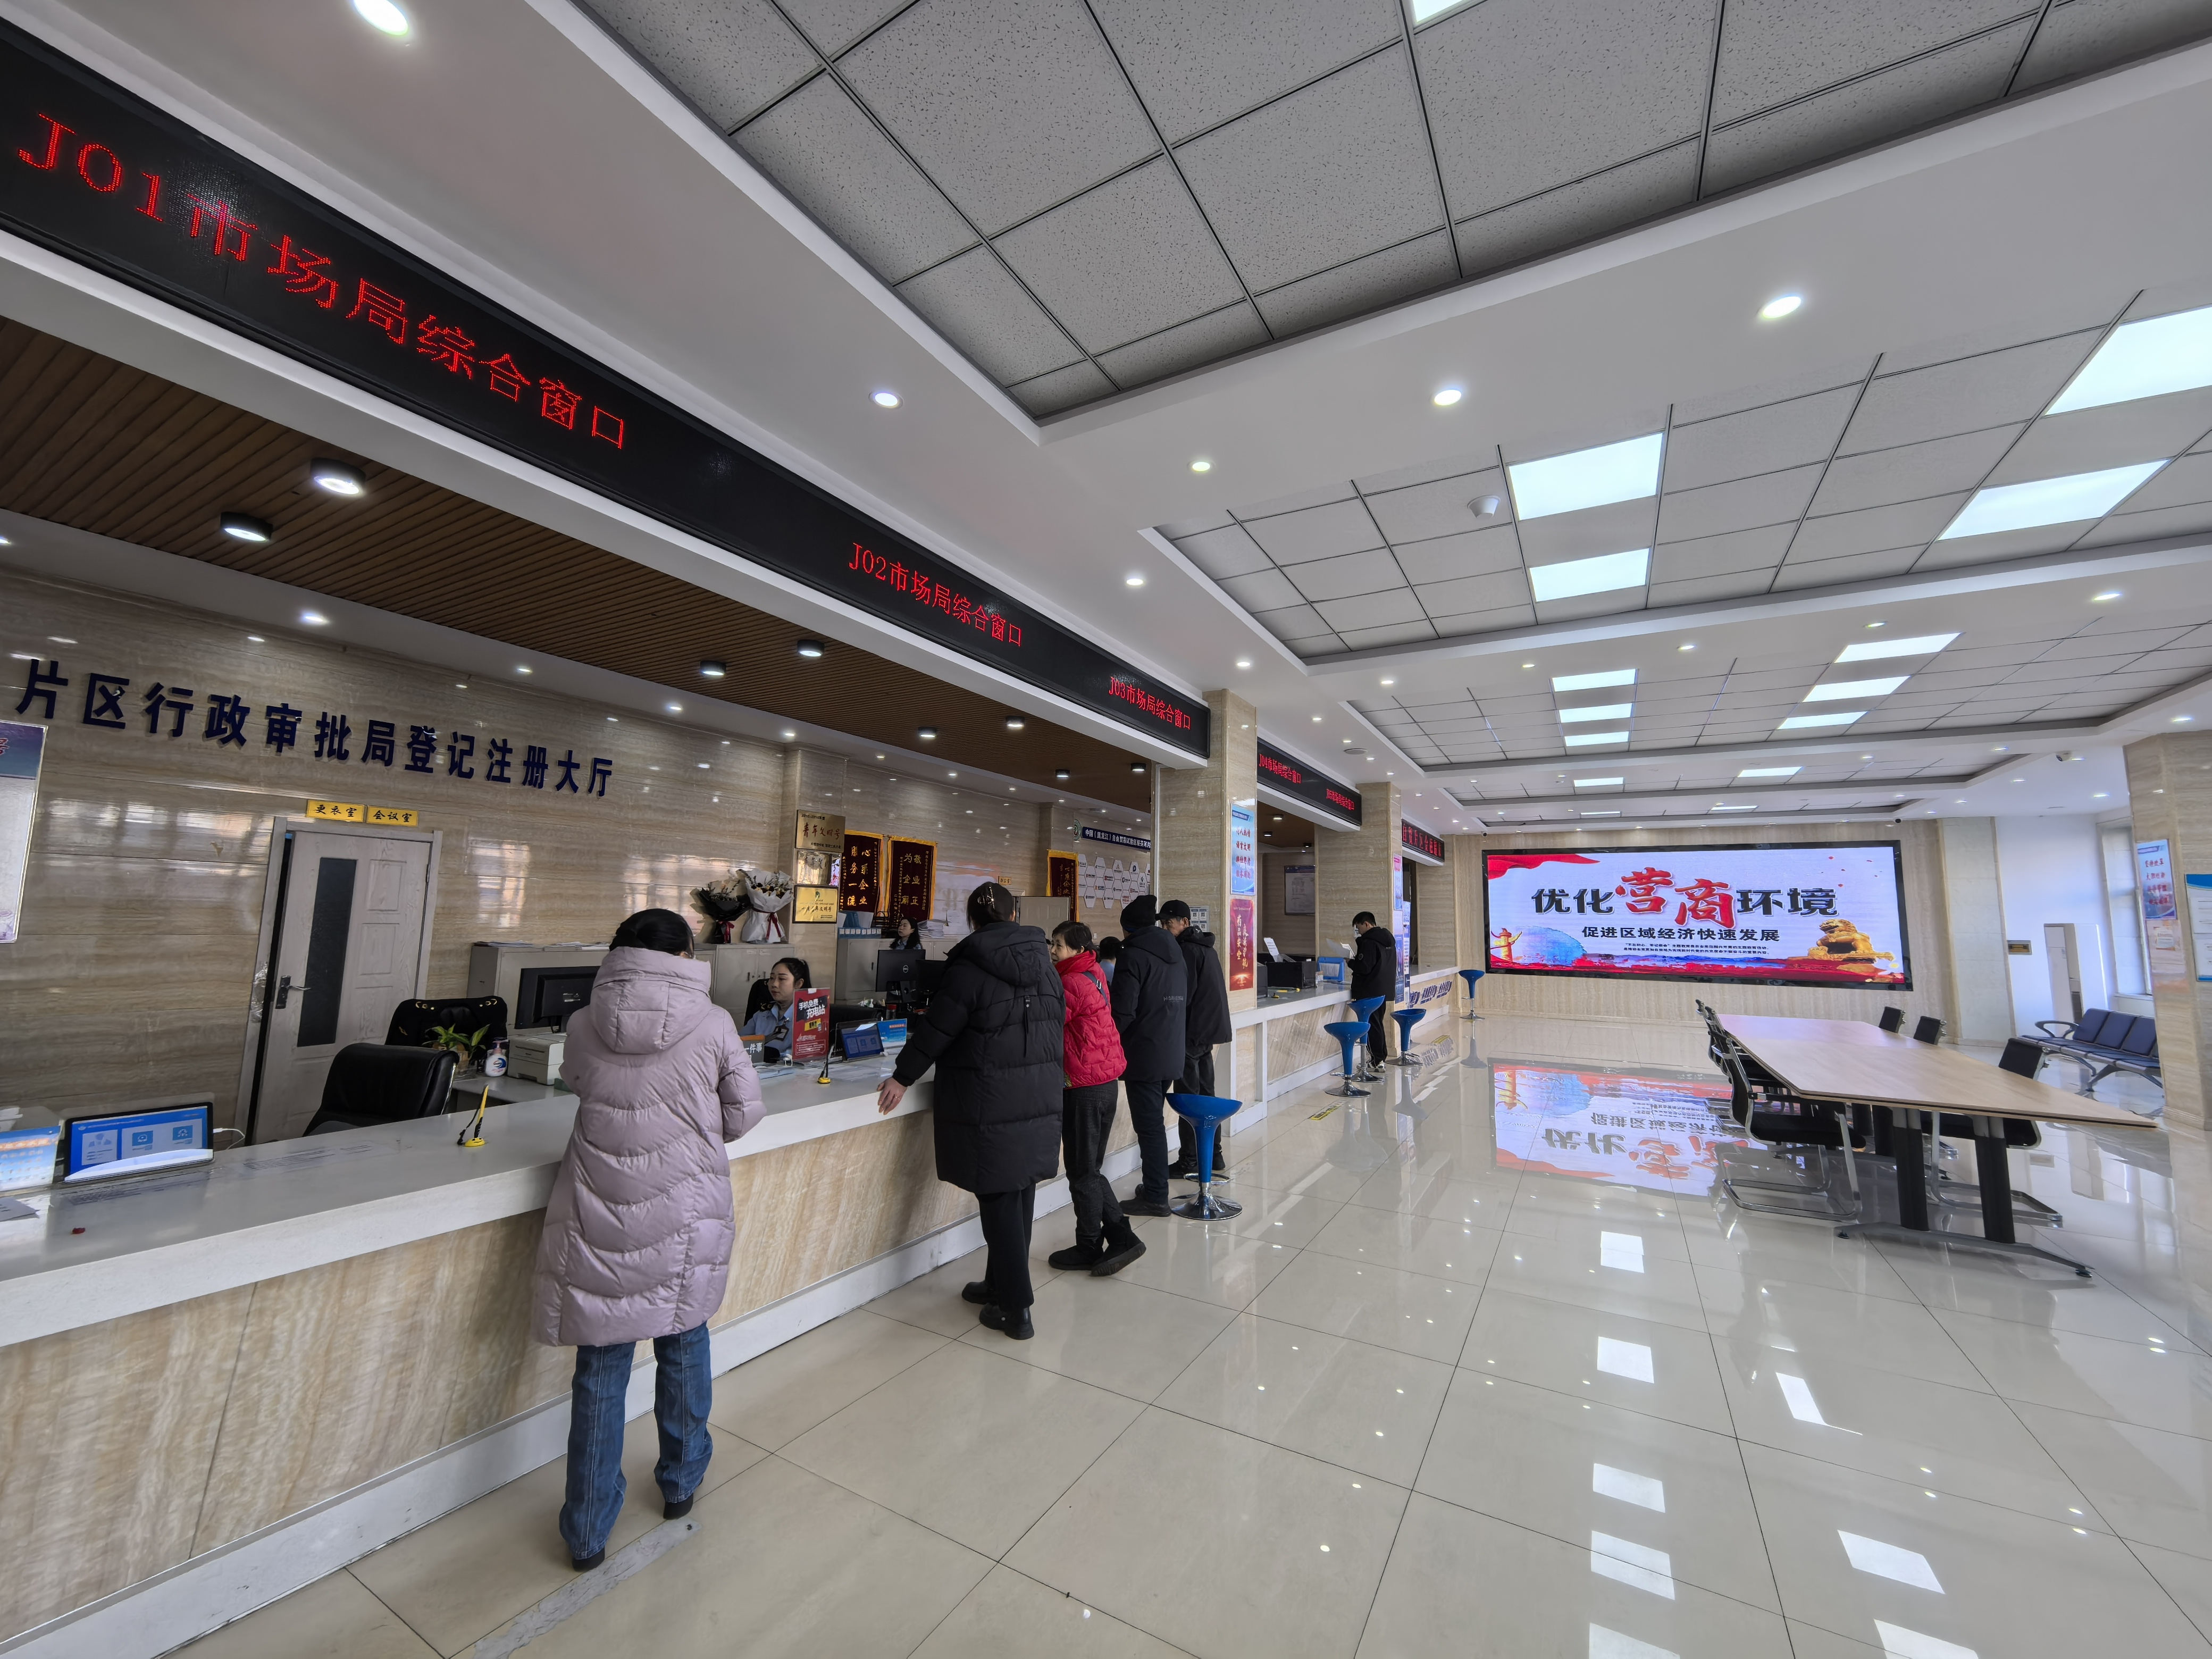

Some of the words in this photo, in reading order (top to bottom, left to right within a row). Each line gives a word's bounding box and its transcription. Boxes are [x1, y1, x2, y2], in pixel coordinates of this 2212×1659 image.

[18, 114, 624, 448] J01市场局综合窗口
[849, 542, 1022, 647] J02市场局综合窗口
[1109, 676, 1191, 731] J03市场局综合窗口
[15, 658, 613, 797] 片区行政审批局登记注册大厅
[314, 805, 357, 817] 更衣室
[373, 810, 412, 823] 会议室
[802, 823, 840, 840] 青年文明号
[859, 849, 871, 905] 心系企业
[1531, 867, 1838, 928] 优化营商环境
[1582, 926, 1780, 941] 促进区域经济快速发展
[799, 999, 819, 1010] 手机免费
[806, 1004, 825, 1018] 充电站
